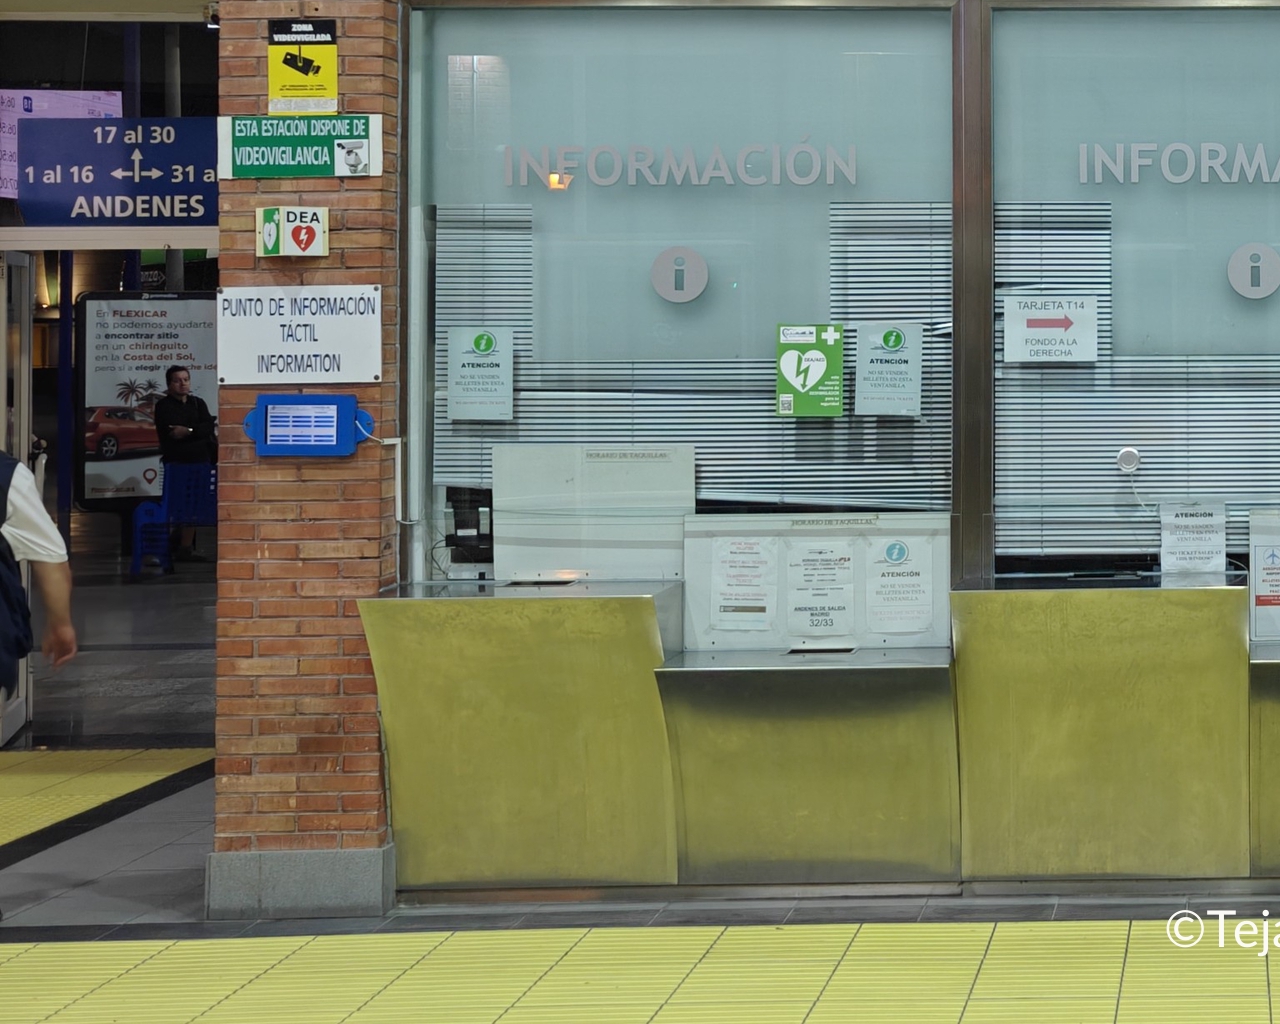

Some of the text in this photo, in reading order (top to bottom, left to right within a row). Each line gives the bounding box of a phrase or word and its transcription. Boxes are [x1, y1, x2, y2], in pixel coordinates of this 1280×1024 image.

[291, 24, 314, 32] ZONA
[273, 34, 332, 42] VIDEOVIGILADA
[93, 125, 175, 144] 17 al 30
[235, 120, 259, 137] ESTA
[311, 119, 350, 136] DISPONE
[353, 119, 366, 136] DE
[234, 146, 331, 166] VIDEOVIGILANCIA
[503, 135, 857, 188] INFORMACIÓN
[25, 164, 94, 184] 1 al 16
[171, 165, 219, 183] 31 a
[70, 195, 205, 218] ANDENES
[286, 210, 321, 225] DEA
[222, 292, 376, 317] PUNTO DE INFORMACIÓN
[1017, 301, 1084, 311] TARJETA T14
[96, 310, 168, 318] En FLEXICAR
[113, 321, 164, 331] podemos
[167, 320, 214, 330] ayudarte
[279, 319, 319, 343] TÁCTIL
[129, 342, 189, 352] chiringuito
[1025, 338, 1077, 346] FONDO A LA
[123, 353, 196, 362] Costa del Sol,
[1029, 349, 1073, 357] DERECHA
[257, 354, 341, 374] INFORMATION
[809, 619, 834, 627] 32/33
